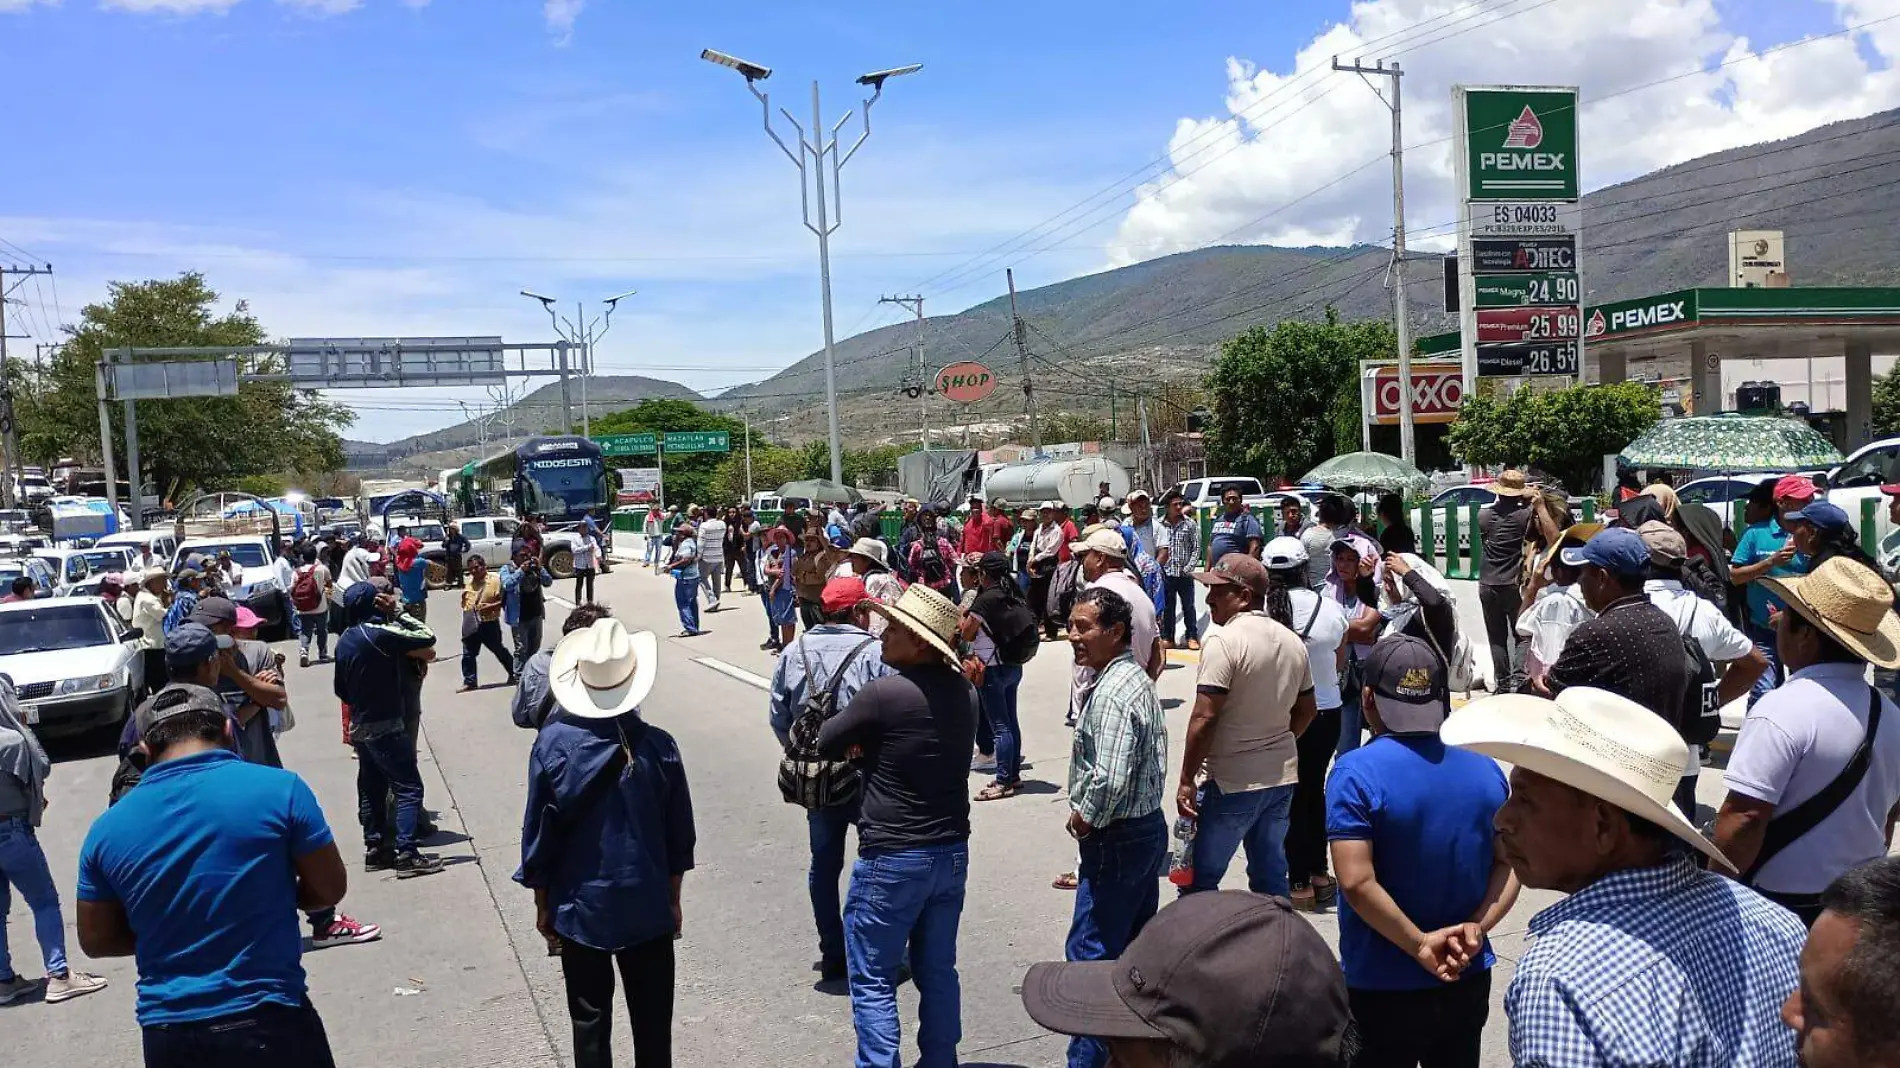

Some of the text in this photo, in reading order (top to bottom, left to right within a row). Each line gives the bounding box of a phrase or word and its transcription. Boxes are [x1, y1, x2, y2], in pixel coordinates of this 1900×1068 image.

[1480, 152, 1565, 171] PEMEX
[1494, 205, 1557, 223] ES 04033
[1499, 287, 1527, 298] Magna
[1529, 278, 1577, 302] 24.90
[1611, 301, 1685, 330] PEMEX
[1530, 314, 1578, 338] 25.99
[1500, 357, 1523, 366] Diesel
[942, 373, 990, 391] SHOP
[614, 436, 654, 445] ACAPULCO
